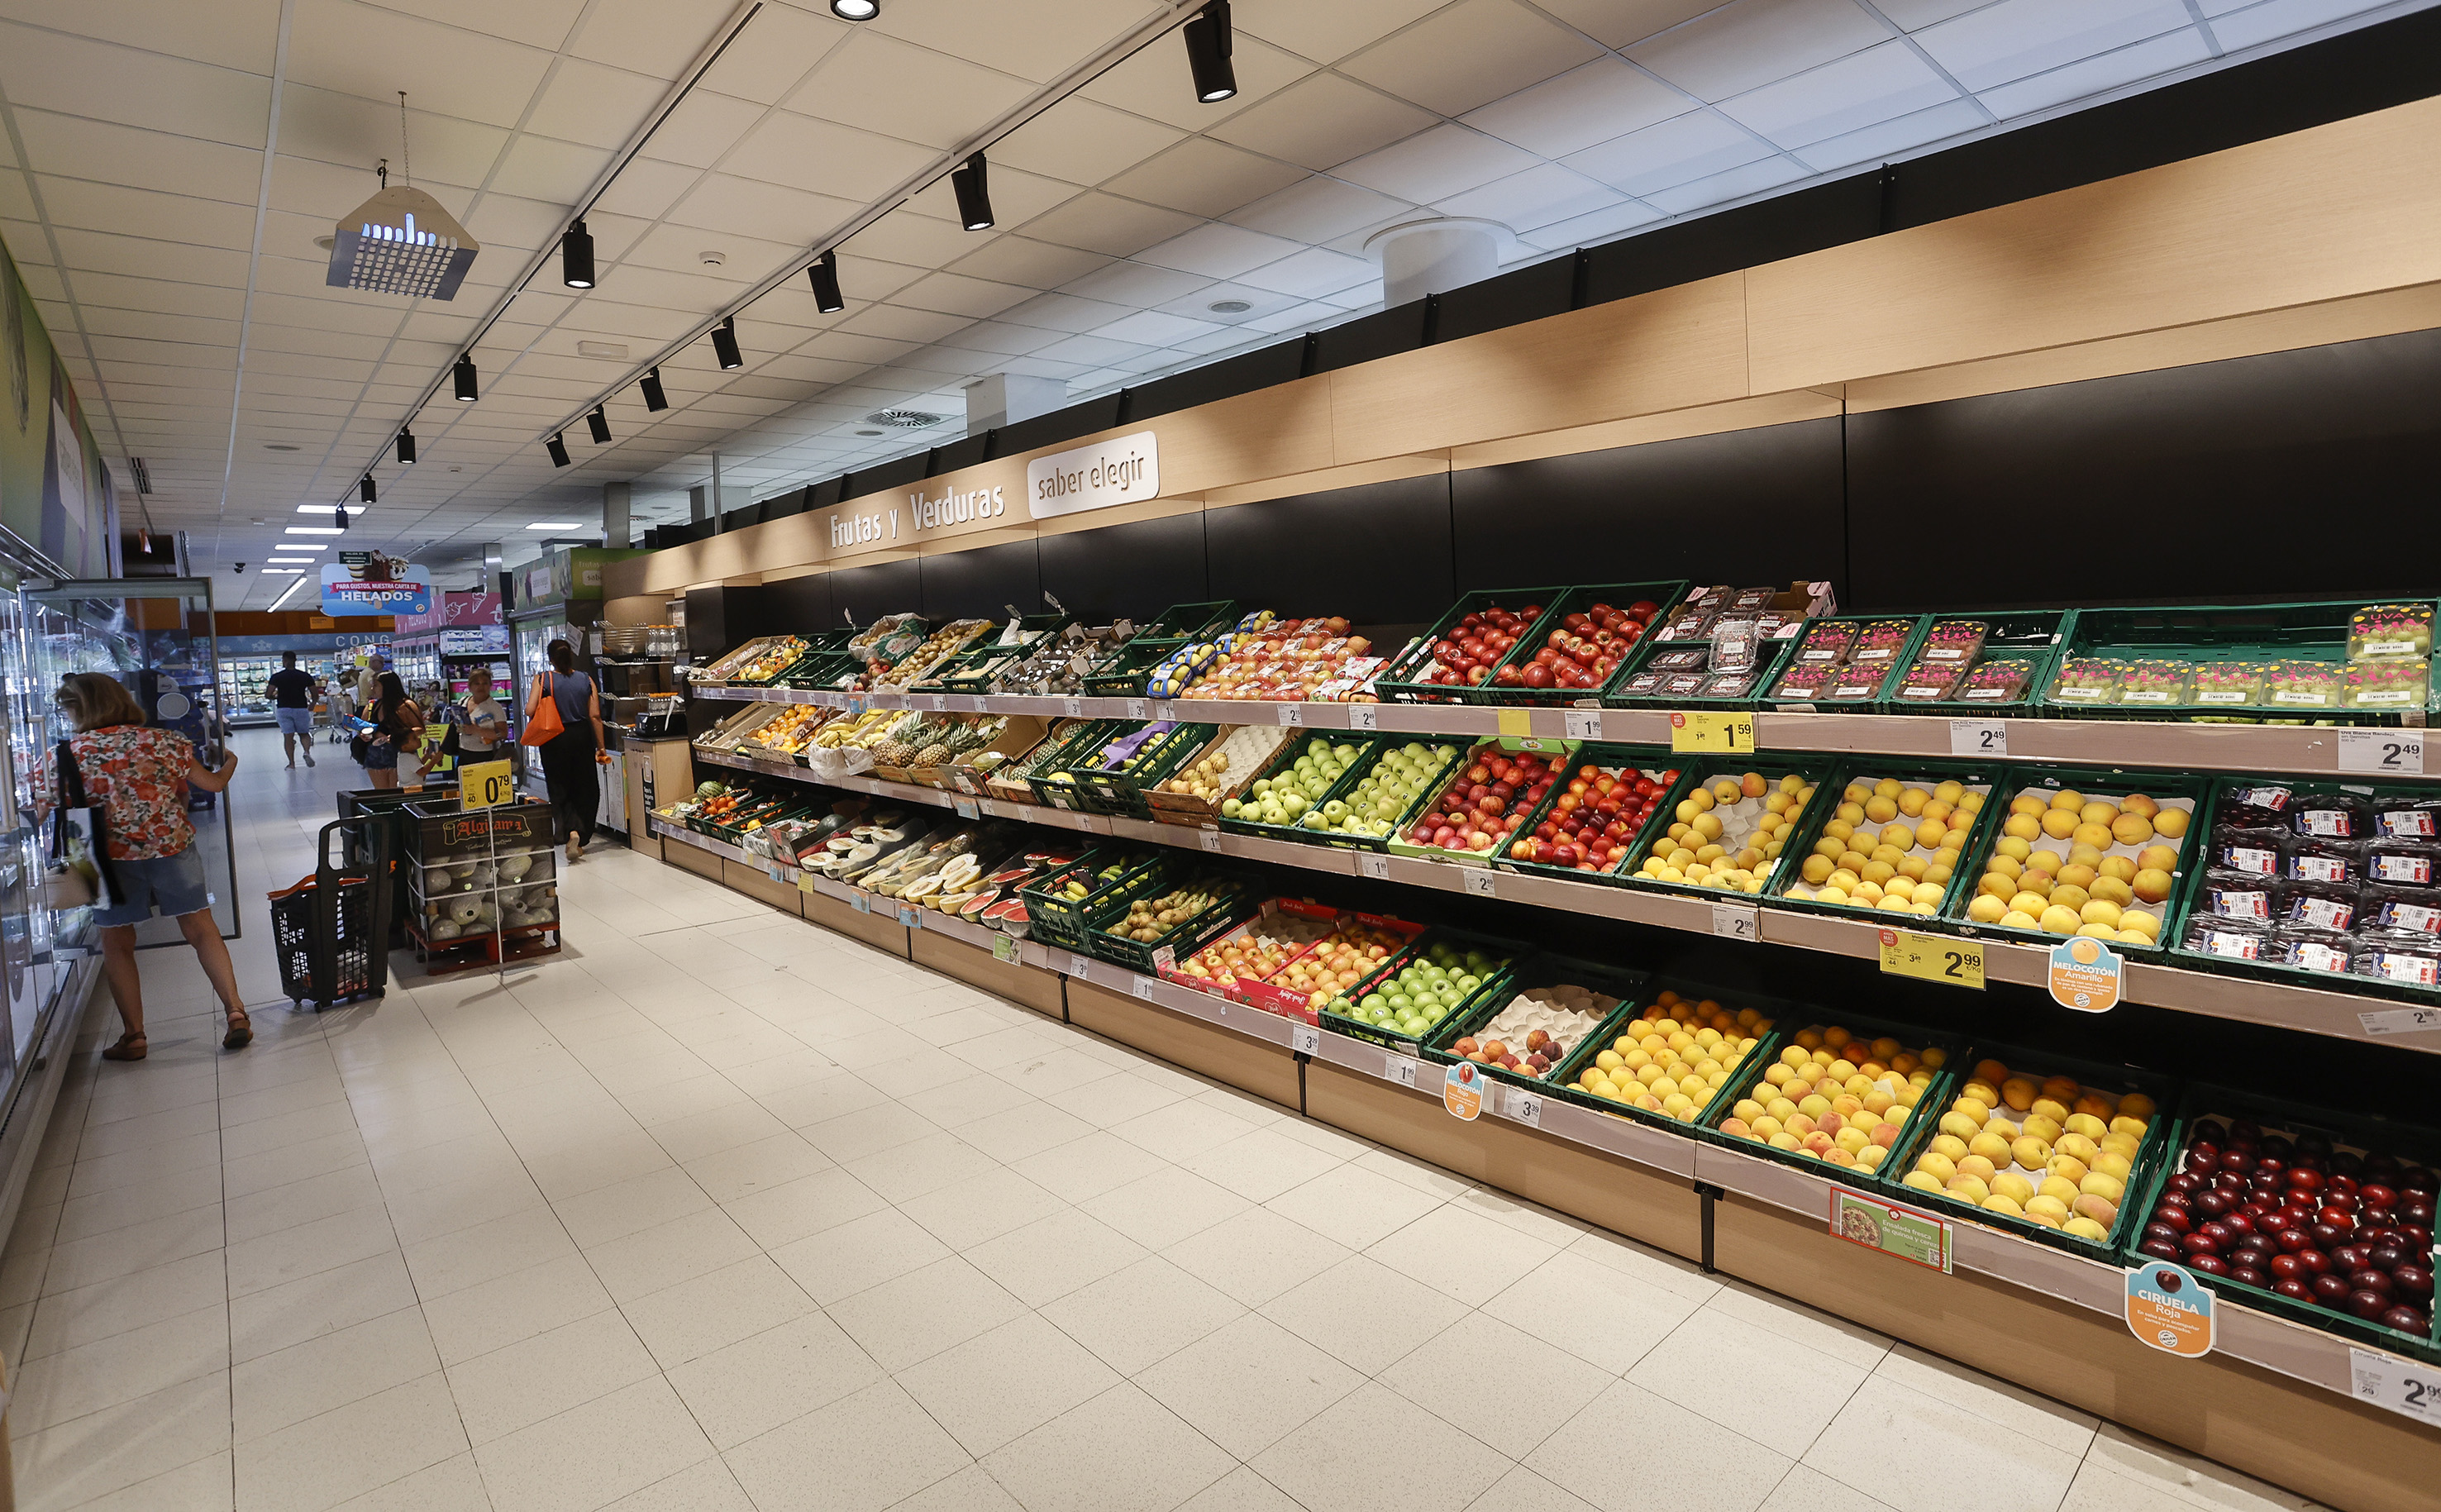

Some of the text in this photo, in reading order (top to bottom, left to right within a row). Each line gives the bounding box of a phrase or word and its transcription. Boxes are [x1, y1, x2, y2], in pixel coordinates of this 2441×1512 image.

[1037, 451, 1145, 501] saber elegir
[830, 485, 1006, 548] Frutas y Verduras
[341, 591, 413, 602] HELADOS
[2355, 618, 2428, 635] sin
[1807, 633, 1851, 644] sin
[1860, 632, 1905, 644] sin
[1929, 631, 1978, 642] sin
[1838, 670, 1886, 682] sin
[1970, 671, 2024, 683] sin
[2061, 669, 2118, 680] sin
[2124, 671, 2185, 683] sin
[2195, 671, 2261, 684] sin
[2270, 671, 2340, 683] sin
[2348, 670, 2423, 684] sin
[2053, 961, 2116, 977] MELOCOTÓN
[2065, 971, 2103, 983] Amarillo
[1447, 1078, 1481, 1095] MELOCOTÓN
[1882, 1219, 1932, 1240] Ensalada fresca
[1891, 1228, 1914, 1242] quinoa
[2138, 1289, 2200, 1315] CIRUELA
[2144, 1311, 2157, 1319] salsa
[2157, 1314, 2170, 1323] para
[2156, 1305, 2181, 1319] Roja
